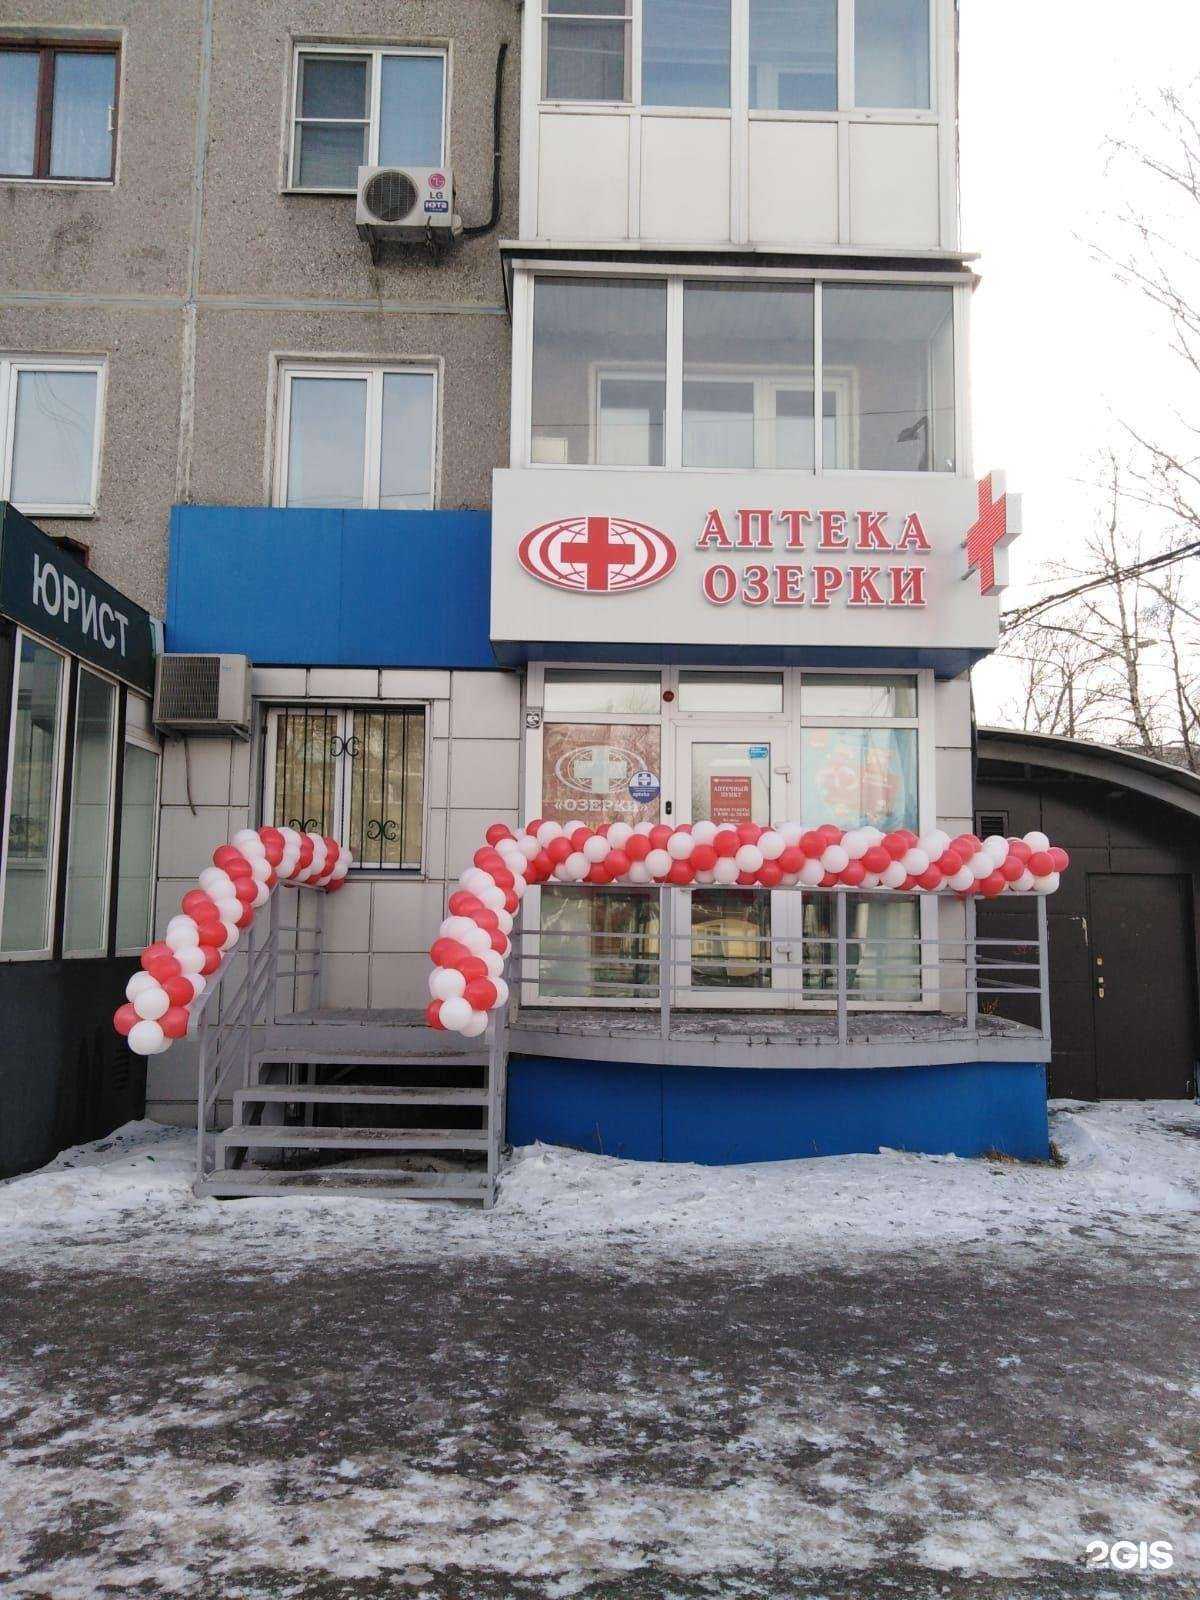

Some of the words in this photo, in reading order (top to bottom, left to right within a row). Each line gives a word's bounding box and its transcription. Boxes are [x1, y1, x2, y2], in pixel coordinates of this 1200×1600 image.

[430, 191, 443, 199] LG
[697, 506, 932, 553] АПТЕКА
[32, 552, 129, 657] ЮРИСТ
[702, 563, 929, 608] ОЗЕРКИ
